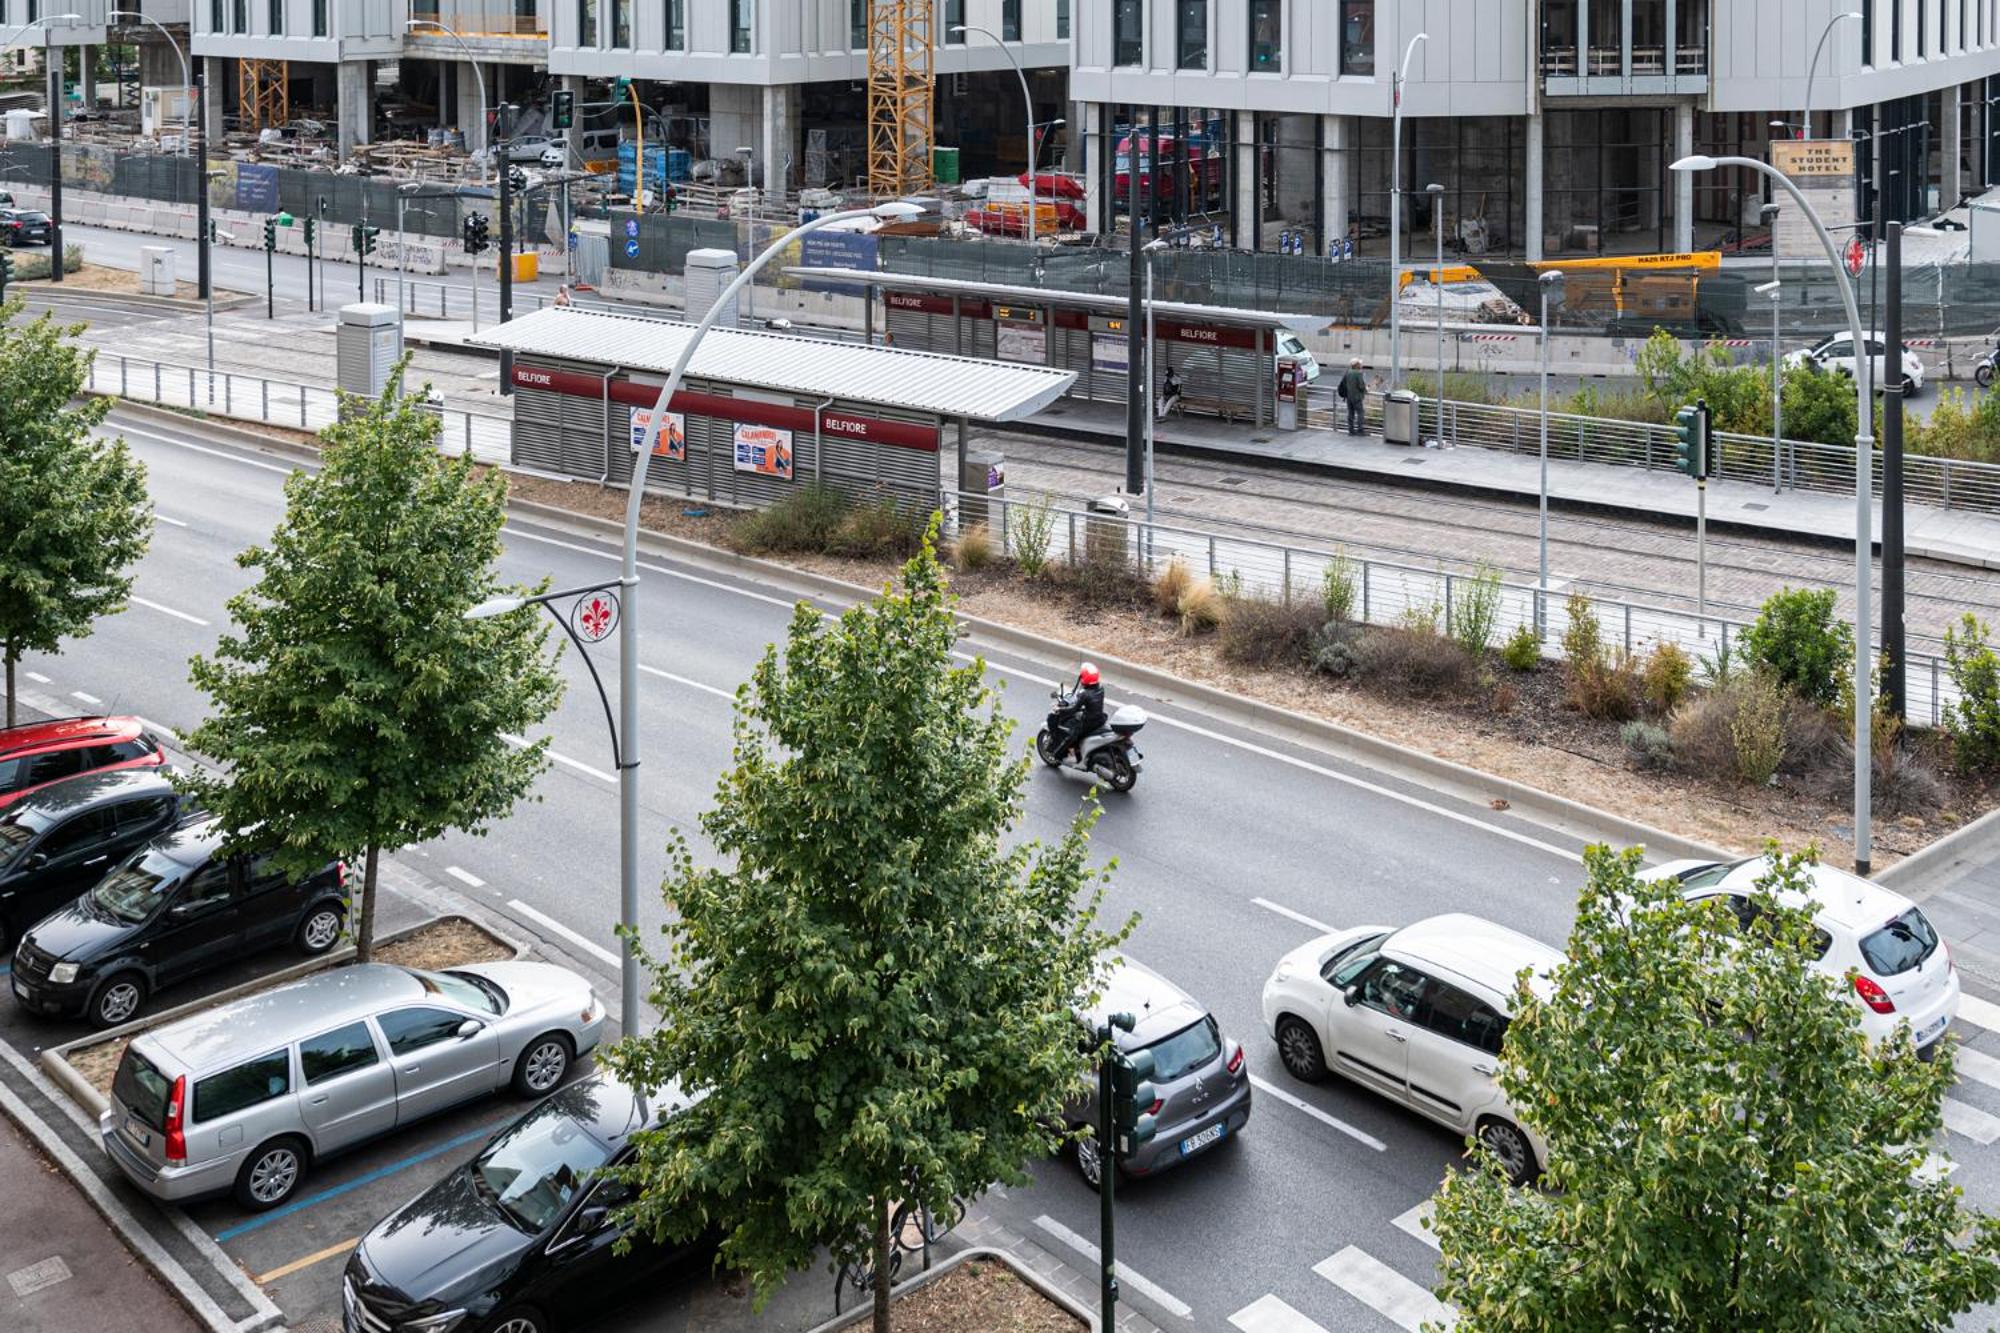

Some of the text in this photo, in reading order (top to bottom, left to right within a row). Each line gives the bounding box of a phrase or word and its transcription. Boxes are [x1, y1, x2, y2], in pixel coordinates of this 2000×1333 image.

[1790, 156, 1848, 164] STUDENT
[890, 297, 921, 307] BELFIORE
[1180, 328, 1216, 340] BELFIORE
[518, 371, 551, 384] BELFIORE
[826, 418, 867, 434] BELFIORE
